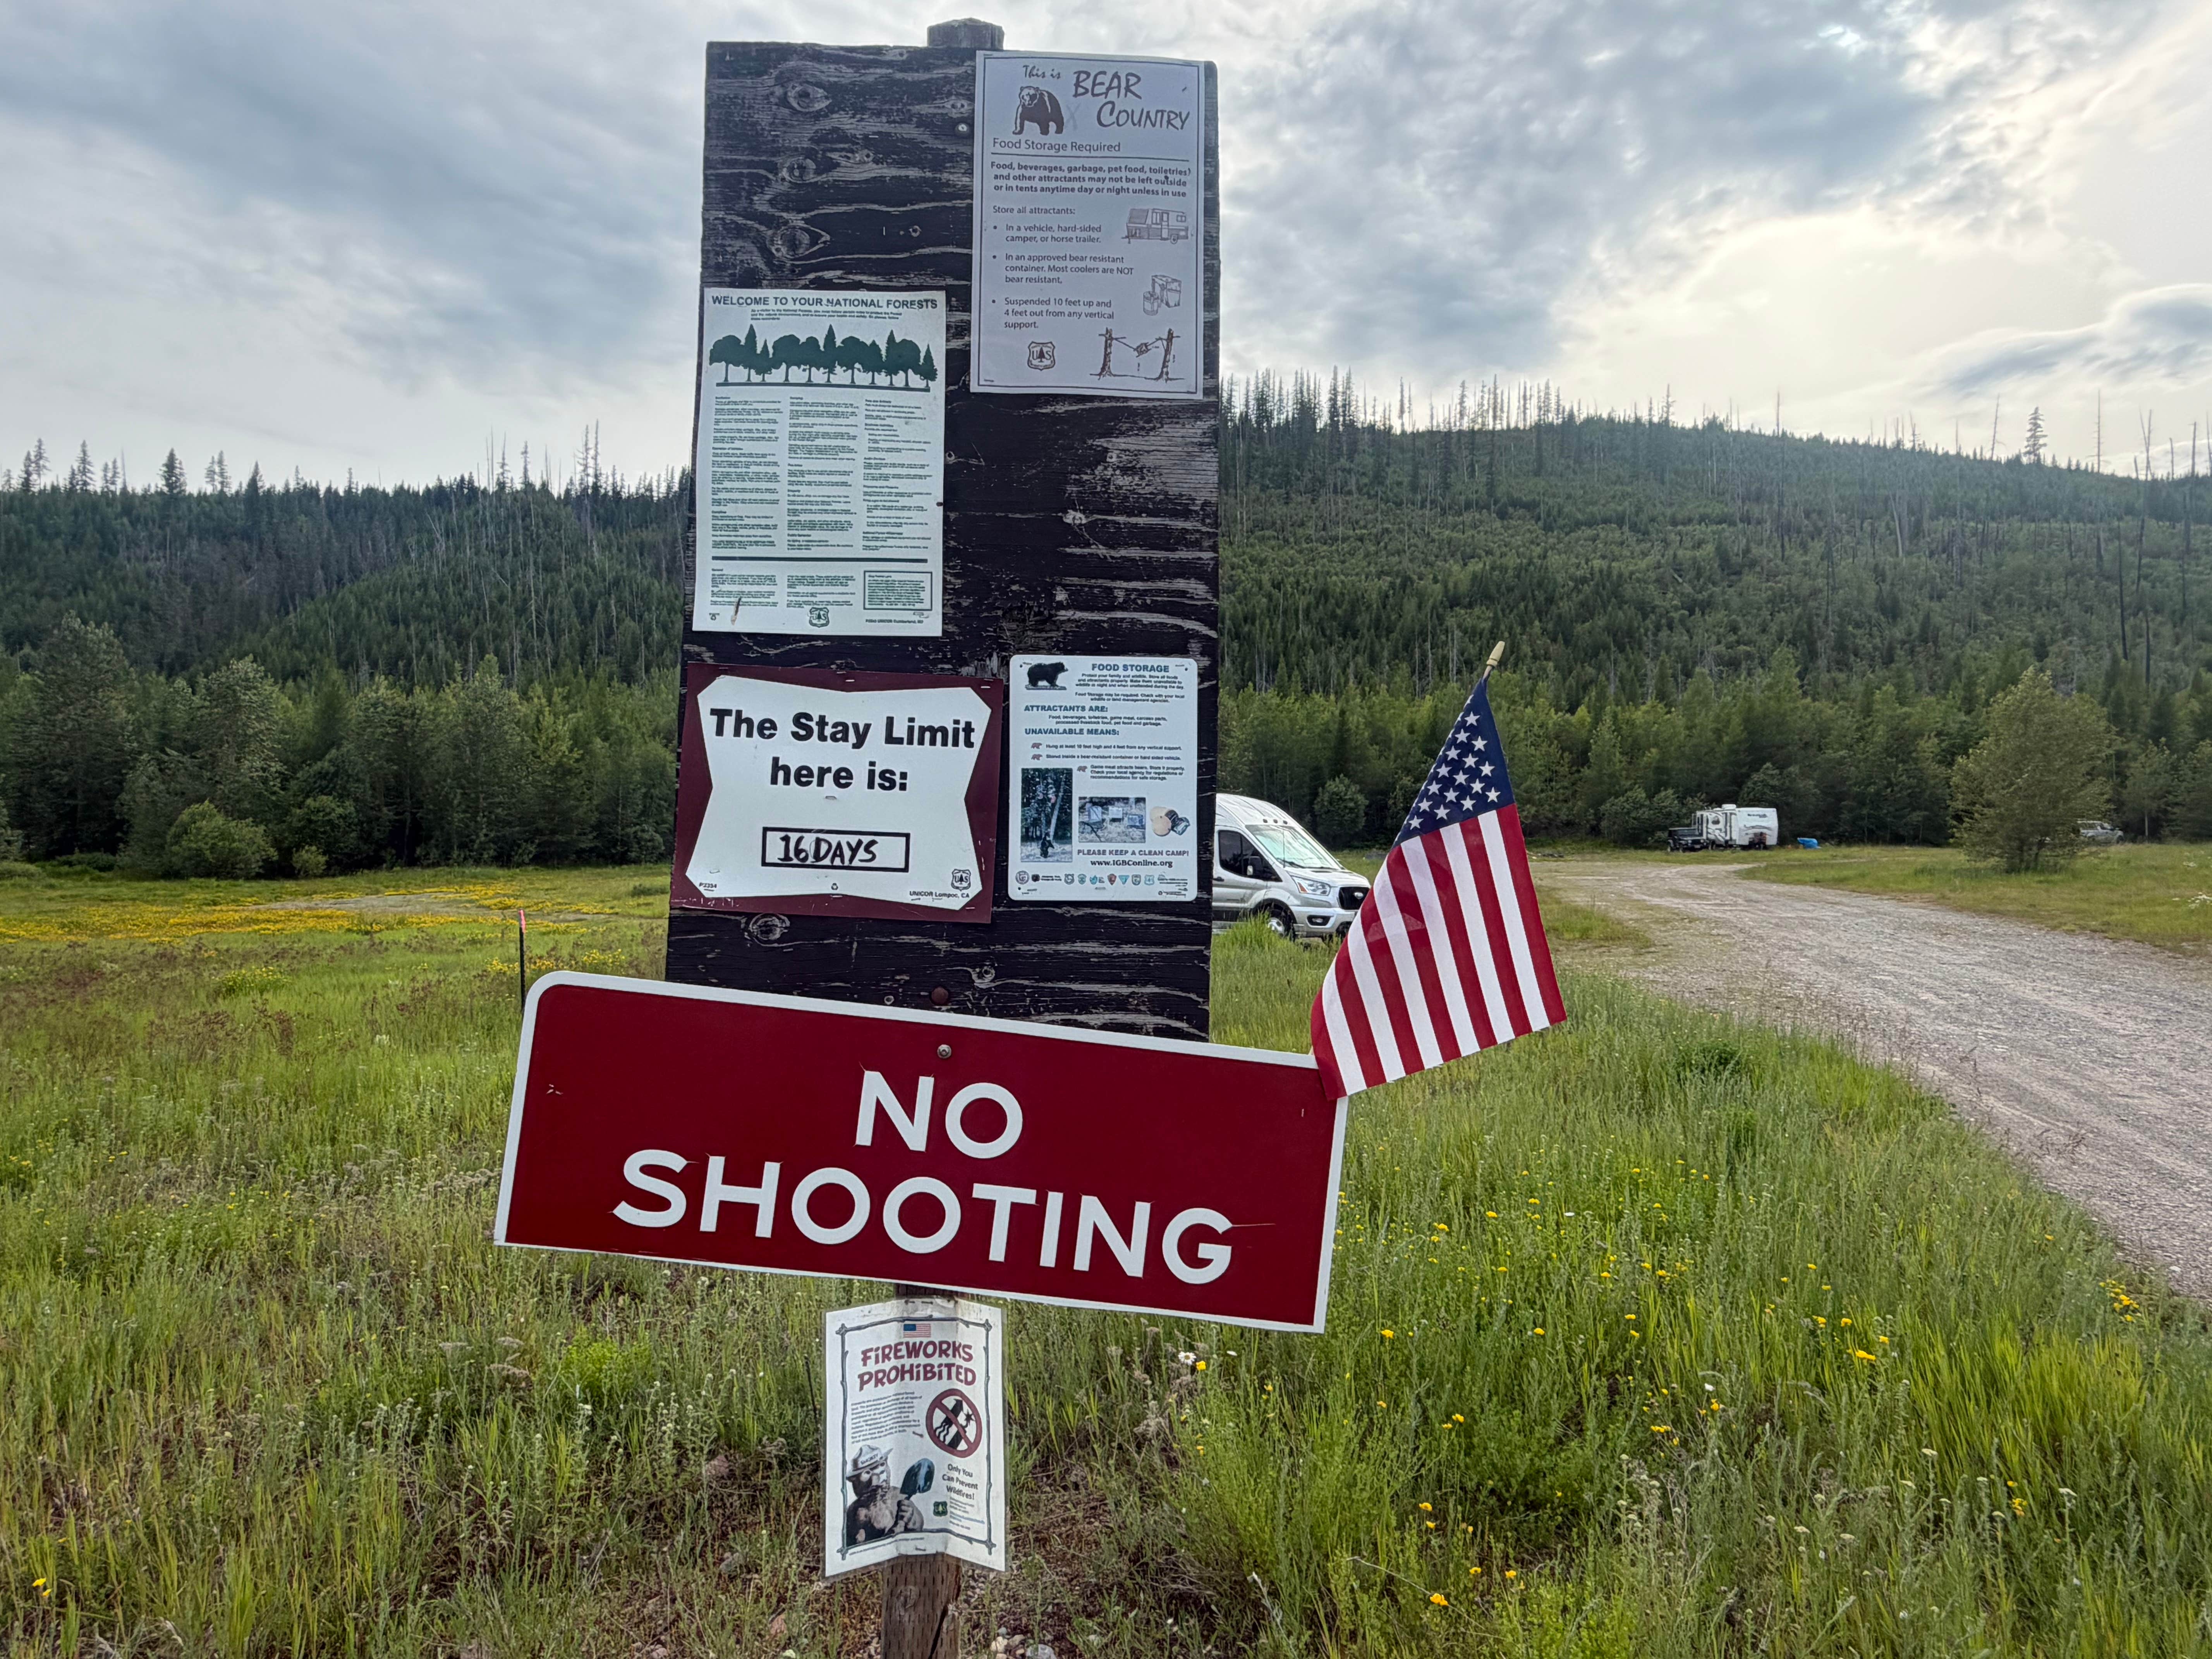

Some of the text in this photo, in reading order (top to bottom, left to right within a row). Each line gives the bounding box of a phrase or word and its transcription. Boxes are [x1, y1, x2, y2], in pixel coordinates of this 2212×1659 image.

[1023, 65, 1061, 79] This is
[1073, 71, 1142, 99] BEAR
[993, 137, 1121, 153] Food Storage Required
[991, 161, 1015, 170] Food,
[1017, 163, 1065, 173] beverages,
[1066, 165, 1106, 173] garbage,
[1124, 165, 1147, 174] food,
[1138, 176, 1152, 184] left
[1039, 185, 1076, 194] anytime
[1077, 185, 1094, 194] day
[1106, 186, 1130, 195] night
[1132, 187, 1159, 195] unless
[993, 205, 1015, 213] Store
[1023, 224, 1055, 232] vehicle,
[1057, 224, 1101, 232] hard-sided
[1027, 254, 1067, 262] approved
[711, 296, 938, 309] WELCOME TO YOUR NATIONAL FORESTS
[1005, 297, 1051, 306] Suspended
[1065, 298, 1081, 306] feet
[1096, 300, 1111, 308] and
[1046, 309, 1066, 317] from
[1004, 321, 1039, 330] support.
[1122, 664, 1170, 673] STORAGE
[709, 709, 975, 749] The Stay Limit
[770, 757, 908, 791] here is:
[1090, 860, 1173, 868] www.IGBConline.org
[855, 1070, 1023, 1159] NO
[612, 1149, 1233, 1285] SHOOTING
[948, 1463, 973, 1478] Only You
[942, 1474, 978, 1490] Can Prevent
